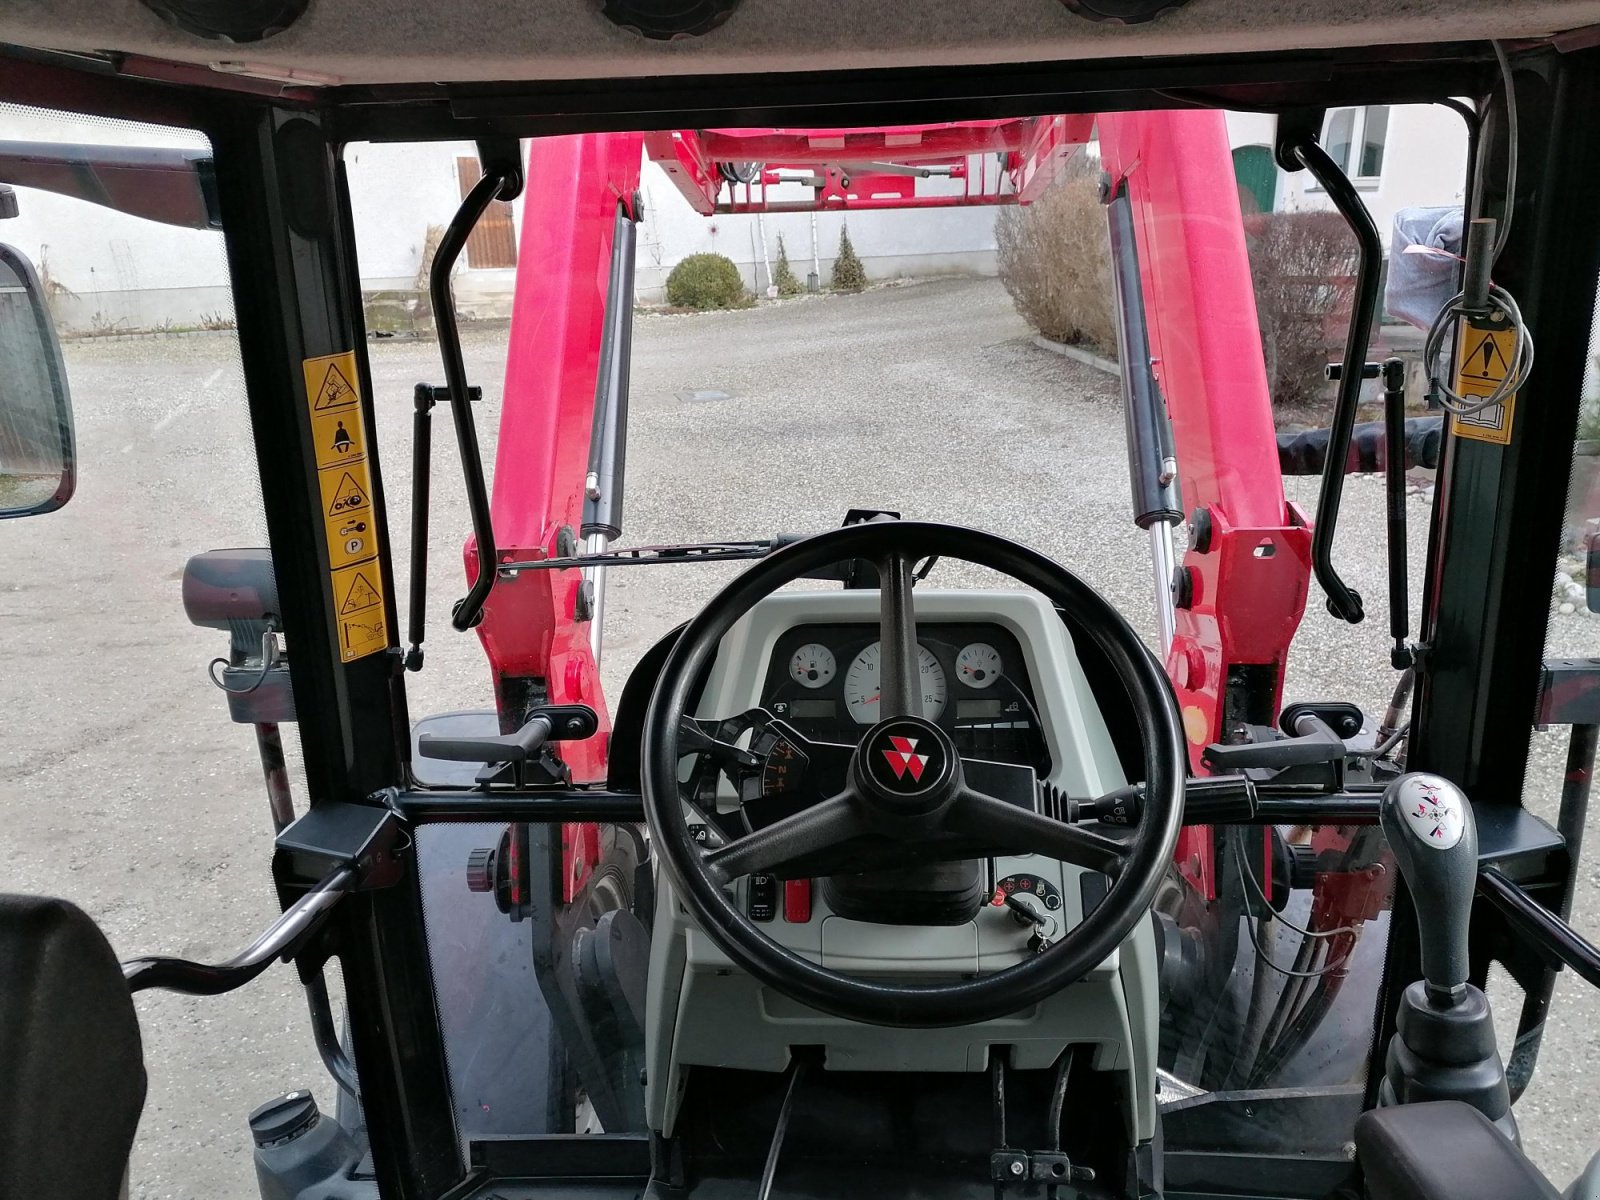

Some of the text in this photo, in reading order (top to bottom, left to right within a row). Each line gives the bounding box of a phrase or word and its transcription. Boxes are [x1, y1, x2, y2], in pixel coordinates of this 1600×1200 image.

[351, 541, 358, 551] P
[867, 663, 874, 671] 10
[921, 666, 929, 674] 20
[860, 695, 866, 703] 5
[924, 694, 933, 703] 25
